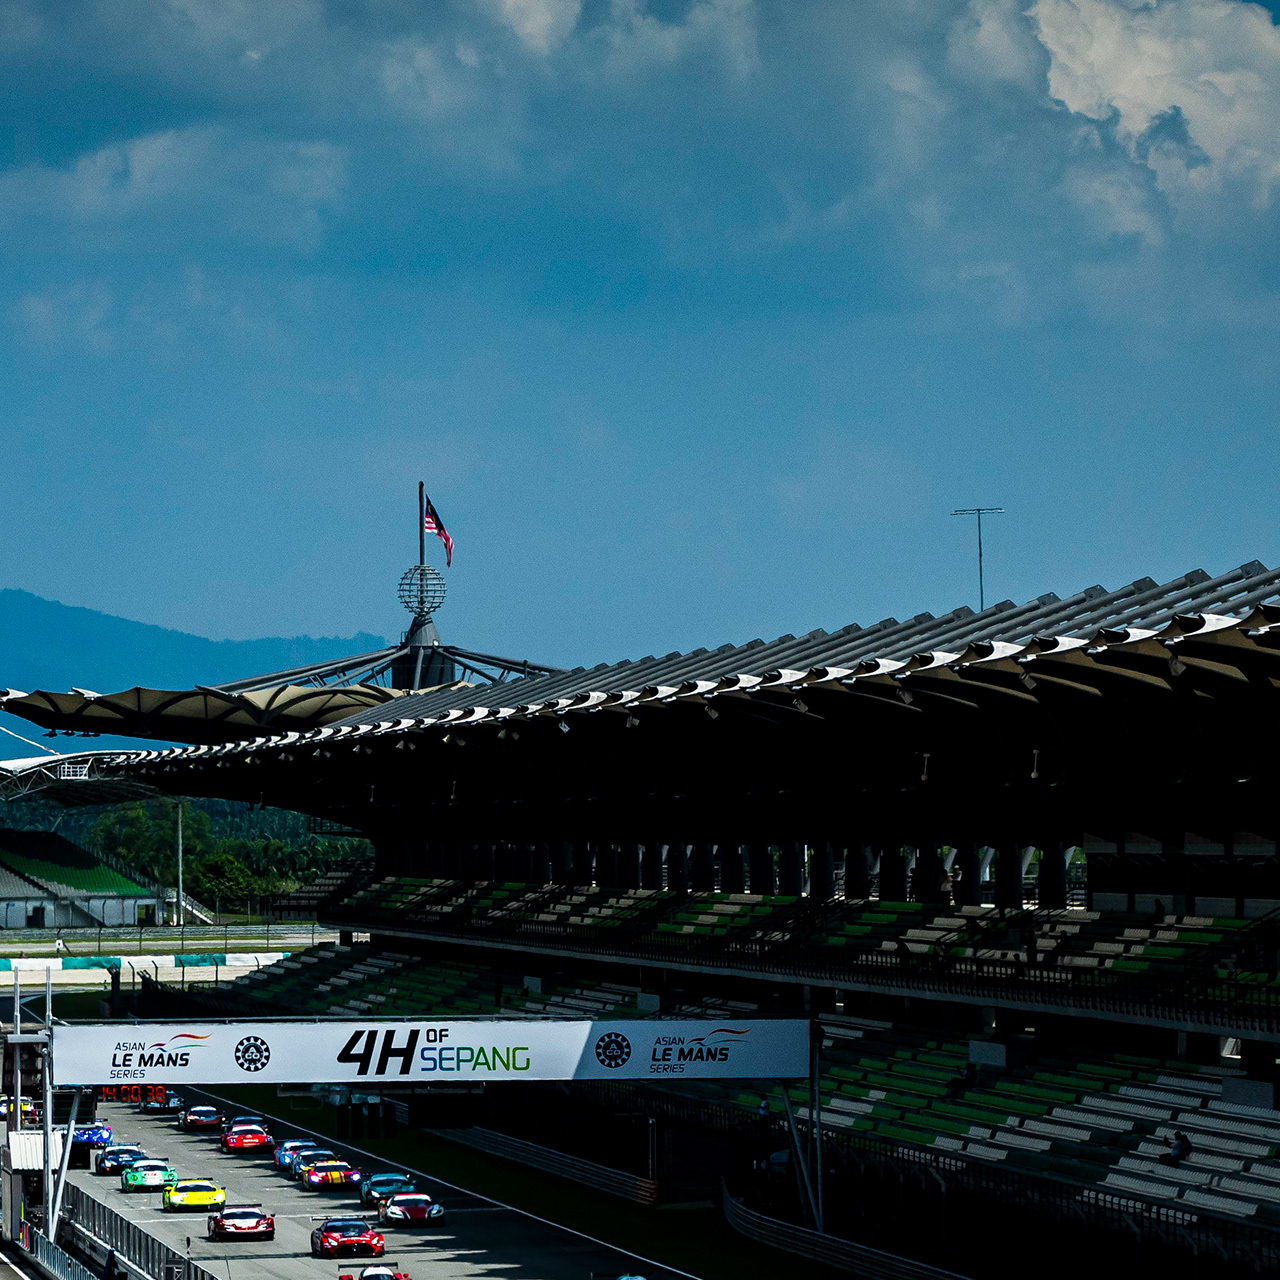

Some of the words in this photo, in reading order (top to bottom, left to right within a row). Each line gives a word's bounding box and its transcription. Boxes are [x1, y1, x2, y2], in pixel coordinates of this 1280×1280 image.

[114, 1042, 146, 1051] ASIAN
[654, 1036, 686, 1046] ASIAN
[336, 1029, 421, 1076] 4H
[426, 1028, 449, 1043] OF
[651, 1047, 673, 1062] LE
[677, 1047, 730, 1062] MANS
[111, 1053, 133, 1067] LE
[137, 1052, 190, 1067] MANS
[420, 1046, 531, 1072] SEPANG
[109, 1069, 146, 1079] SERIES
[649, 1063, 685, 1074] SERIES
